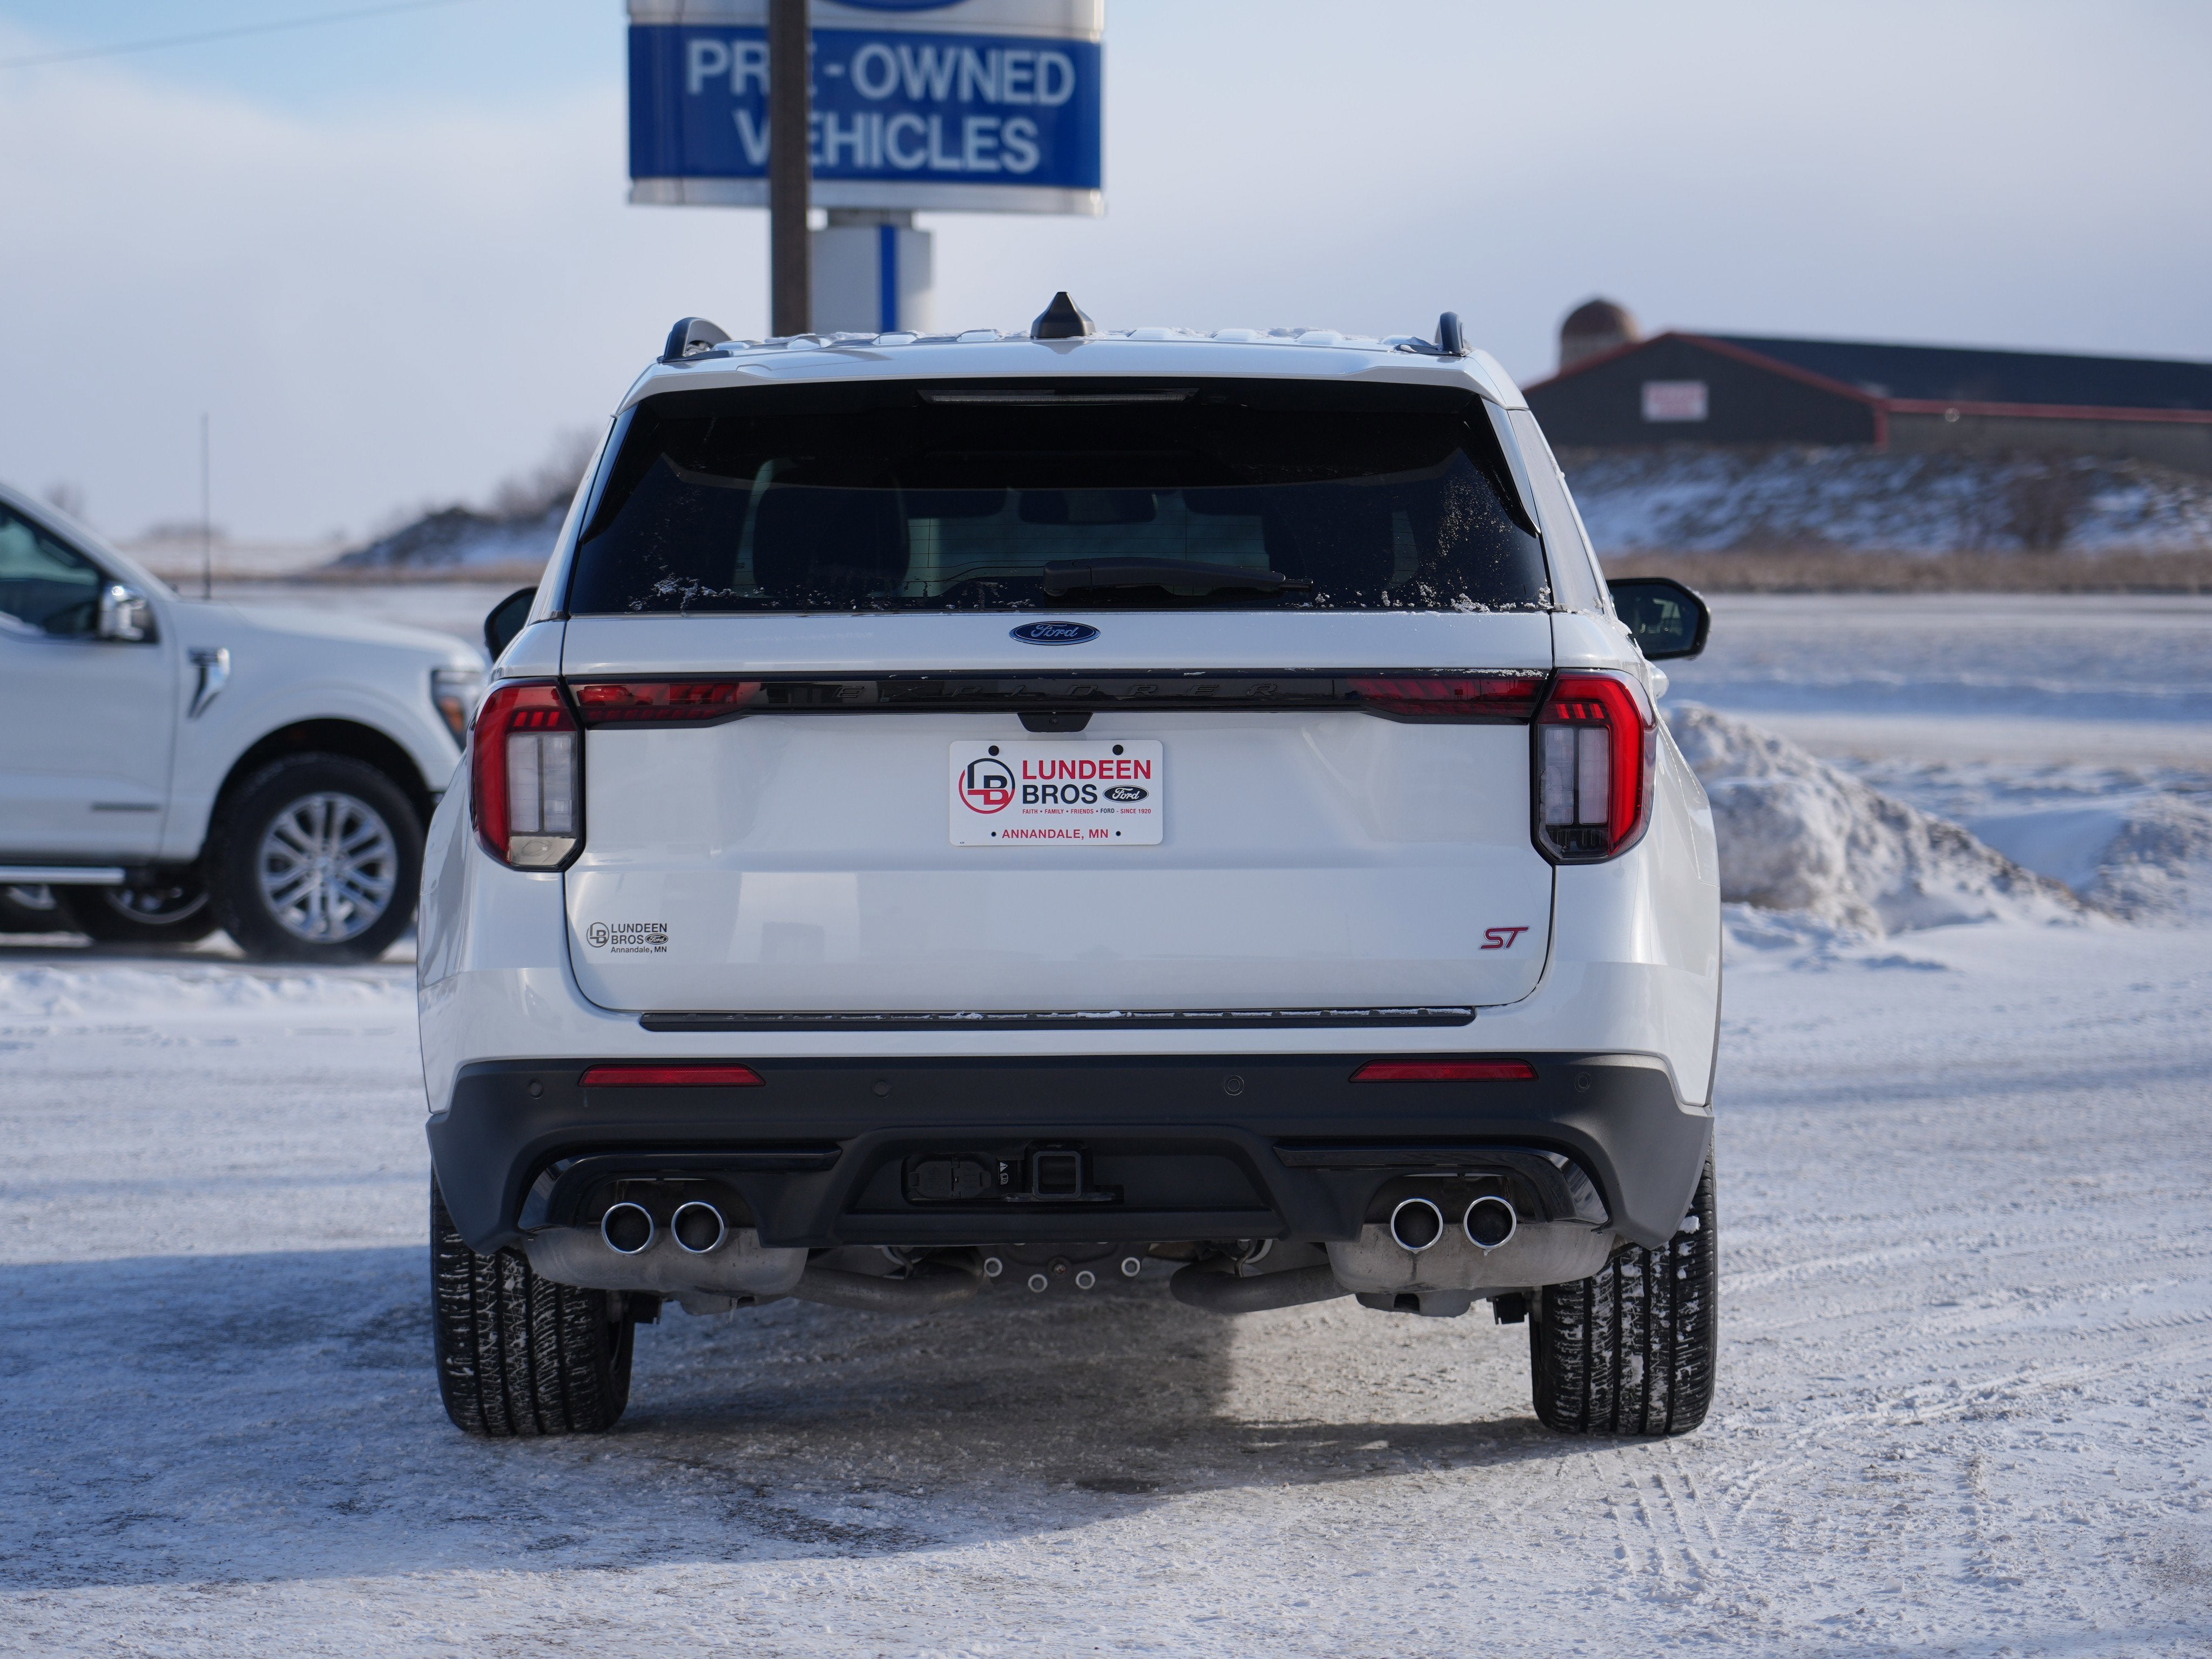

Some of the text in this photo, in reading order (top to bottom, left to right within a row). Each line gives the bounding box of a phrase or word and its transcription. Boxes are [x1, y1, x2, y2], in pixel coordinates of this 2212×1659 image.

[686, 39, 1075, 105] PR-OWNED
[1030, 623, 1080, 637] Ford
[832, 684, 1278, 699] EXPLORER
[1022, 760, 1151, 779] LUNDEEN
[1022, 784, 1140, 804] BROS Ford
[1002, 829, 1108, 840] ANNANDALE, MN
[611, 923, 667, 933] LUNDEEN
[611, 935, 644, 945] BROS
[1479, 926, 1530, 950] ST
